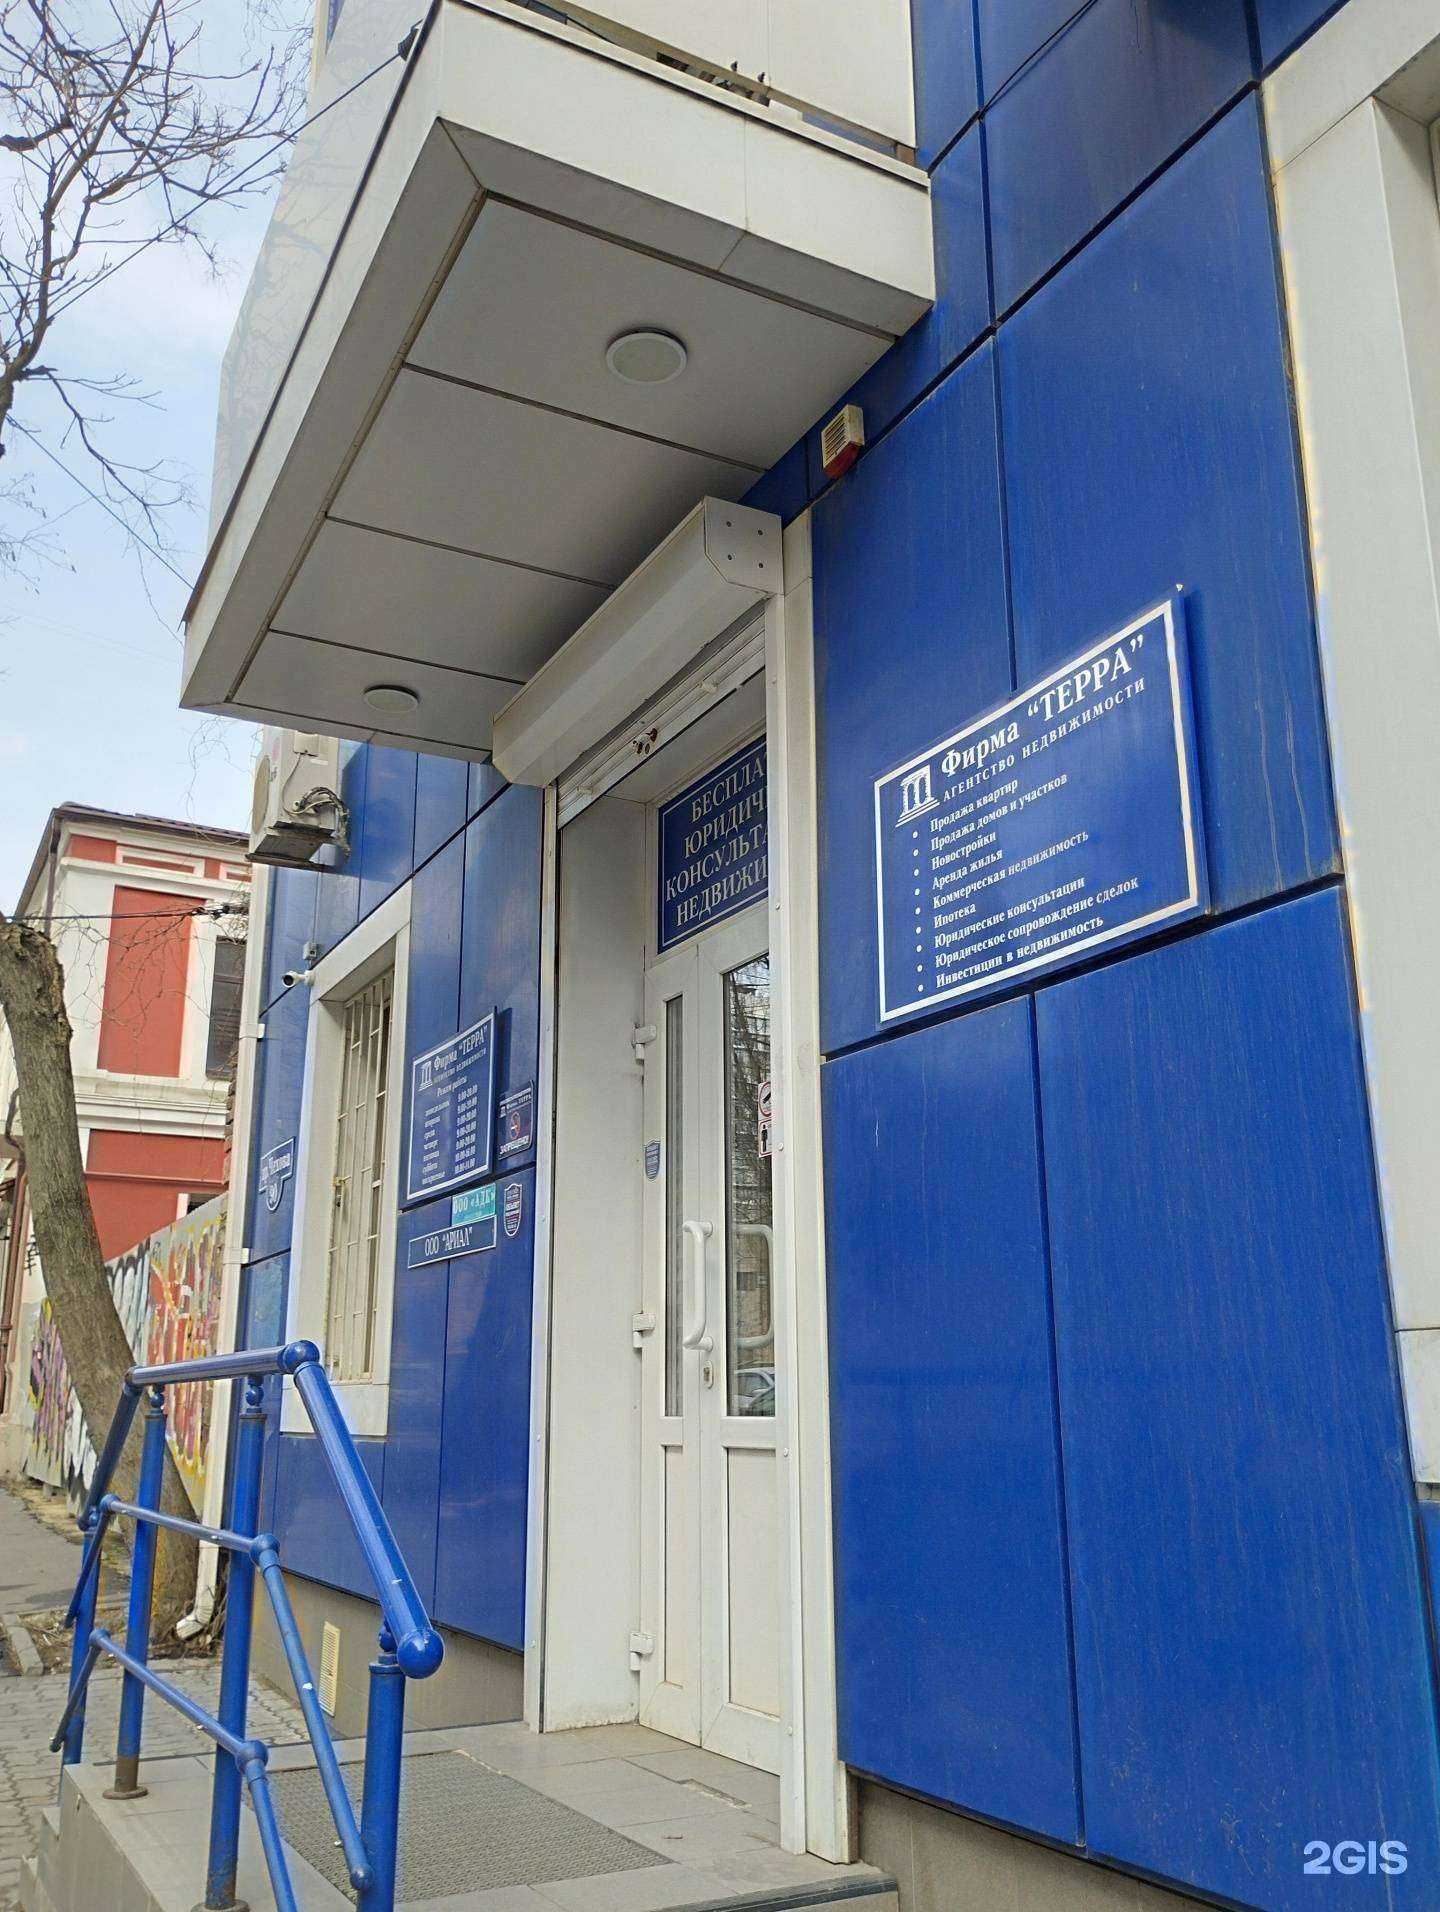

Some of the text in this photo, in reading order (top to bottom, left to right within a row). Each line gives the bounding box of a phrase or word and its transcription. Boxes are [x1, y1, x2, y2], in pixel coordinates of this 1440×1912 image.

[942, 722, 1020, 777] Фирма
[944, 678, 1144, 802] АГЕНТСТВО НЕДВИЖИМОСТИ
[691, 751, 767, 823] БЕСПЛА
[930, 780, 1017, 832] Продажа квартир
[930, 774, 1067, 851] Продажа домов и участков
[684, 787, 767, 859] ЮРИДИЧ
[931, 832, 996, 870] Новостройки
[932, 850, 1002, 890] Аренда жилья
[933, 832, 1088, 909] Коммерческая недвижимость
[934, 904, 976, 928] Ипотека
[935, 878, 1084, 948] Юридические консультации
[935, 877, 1138, 967] Юридическое сопровождение сделок
[936, 917, 1104, 988] Инвестиции в недвижимость
[424, 1236, 440, 1256] ООО
